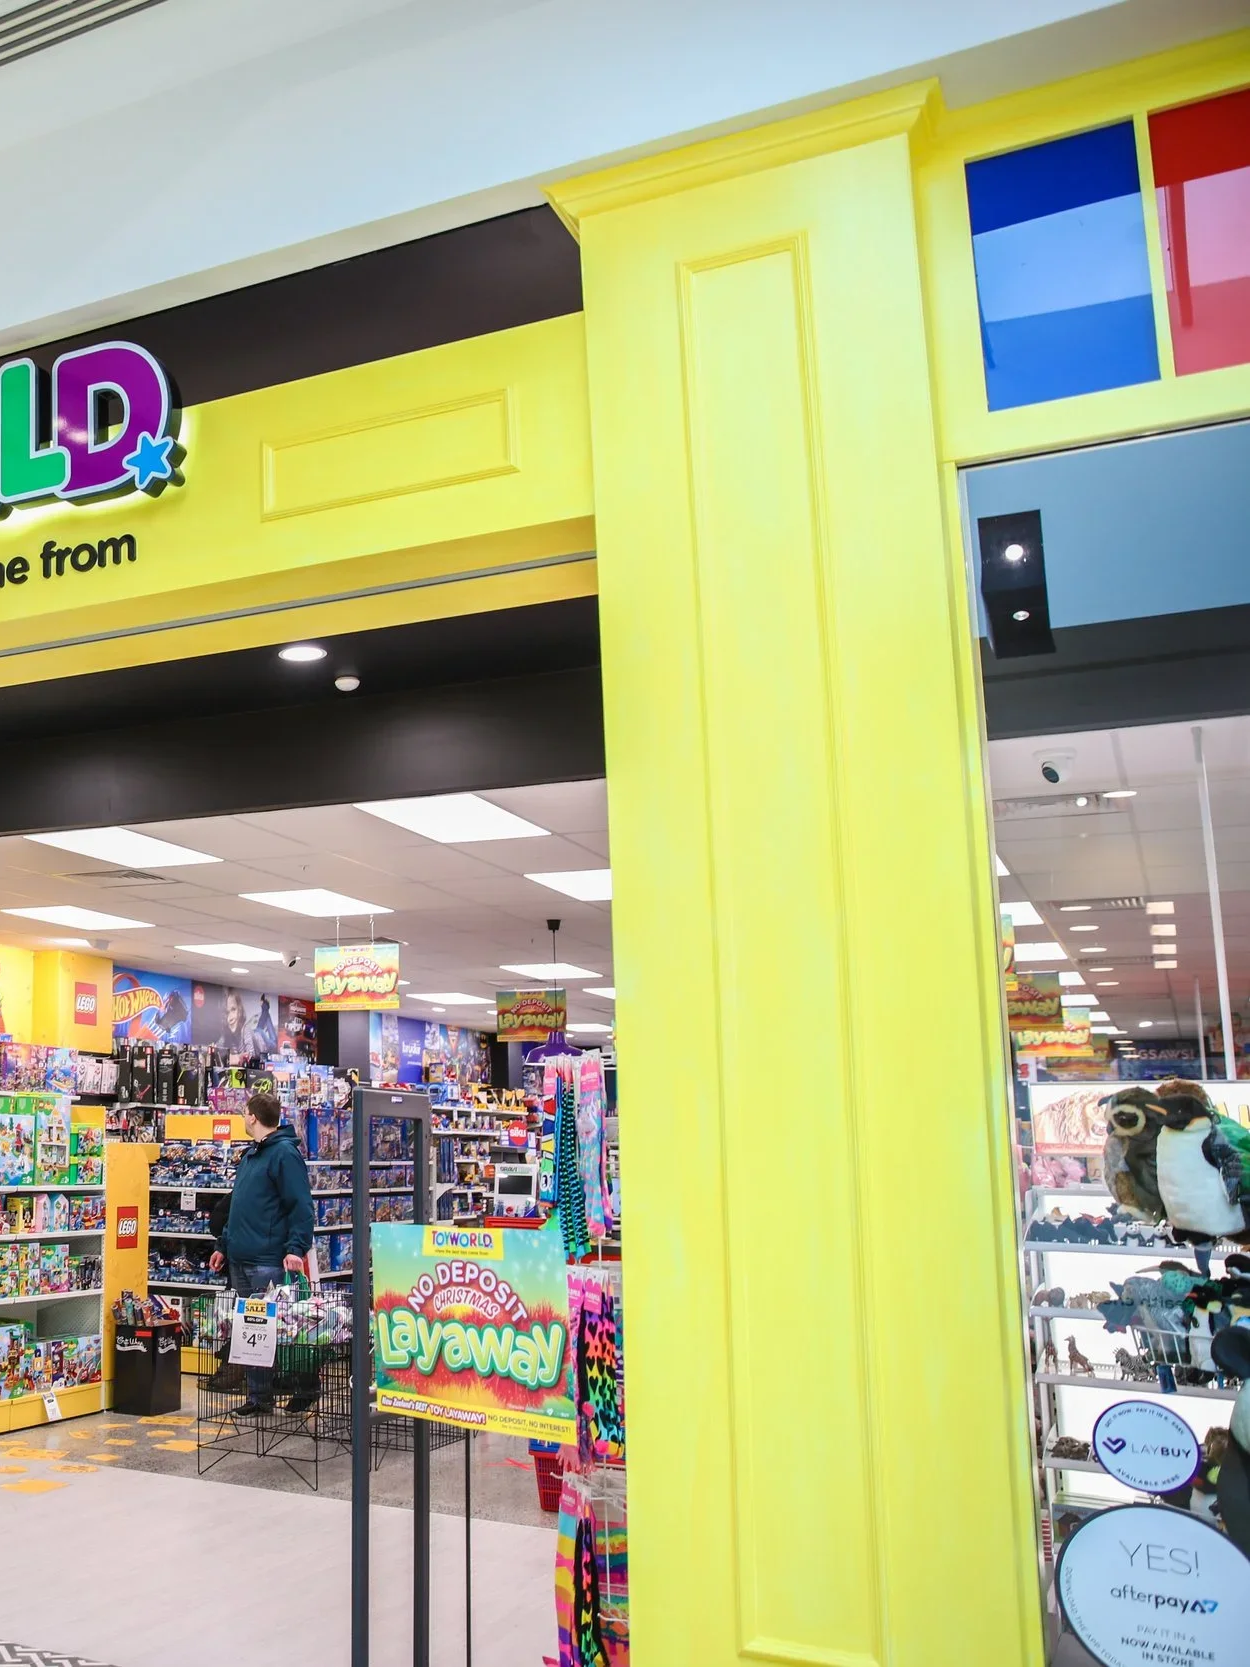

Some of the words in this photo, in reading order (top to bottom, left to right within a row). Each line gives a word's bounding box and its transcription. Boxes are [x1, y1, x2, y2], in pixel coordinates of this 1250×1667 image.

[39, 533, 138, 579] from
[345, 956, 384, 977] DEPOSIT
[316, 971, 398, 996] Layaway
[76, 993, 96, 1014] LEGO
[129, 988, 162, 1017] WHEELS
[213, 1125, 230, 1136] LEGO
[117, 1217, 137, 1237] LEGO
[431, 1230, 493, 1249] TOYWORLD
[408, 1273, 434, 1313] NO
[435, 1260, 528, 1322] DEPOSIT
[245, 1305, 266, 1313] SALE
[433, 1287, 499, 1319] CHRISTMAS
[377, 1309, 564, 1388] Layaway
[429, 1404, 444, 1417] TOY
[444, 1406, 487, 1425] LAYAWAY!
[488, 1414, 498, 1422] NO
[529, 1419, 539, 1428] NO
[539, 1421, 571, 1434] INTEREST!
[1131, 1443, 1191, 1459] LAYBUY
[1117, 1468, 1159, 1486] AVAILABLE
[1119, 1540, 1200, 1578] YES!
[1110, 1583, 1190, 1615] afterpay
[1121, 1636, 1150, 1649] NOW
[1152, 1642, 1216, 1662] AVAILABLE
[1141, 1651, 1154, 1661] IN
